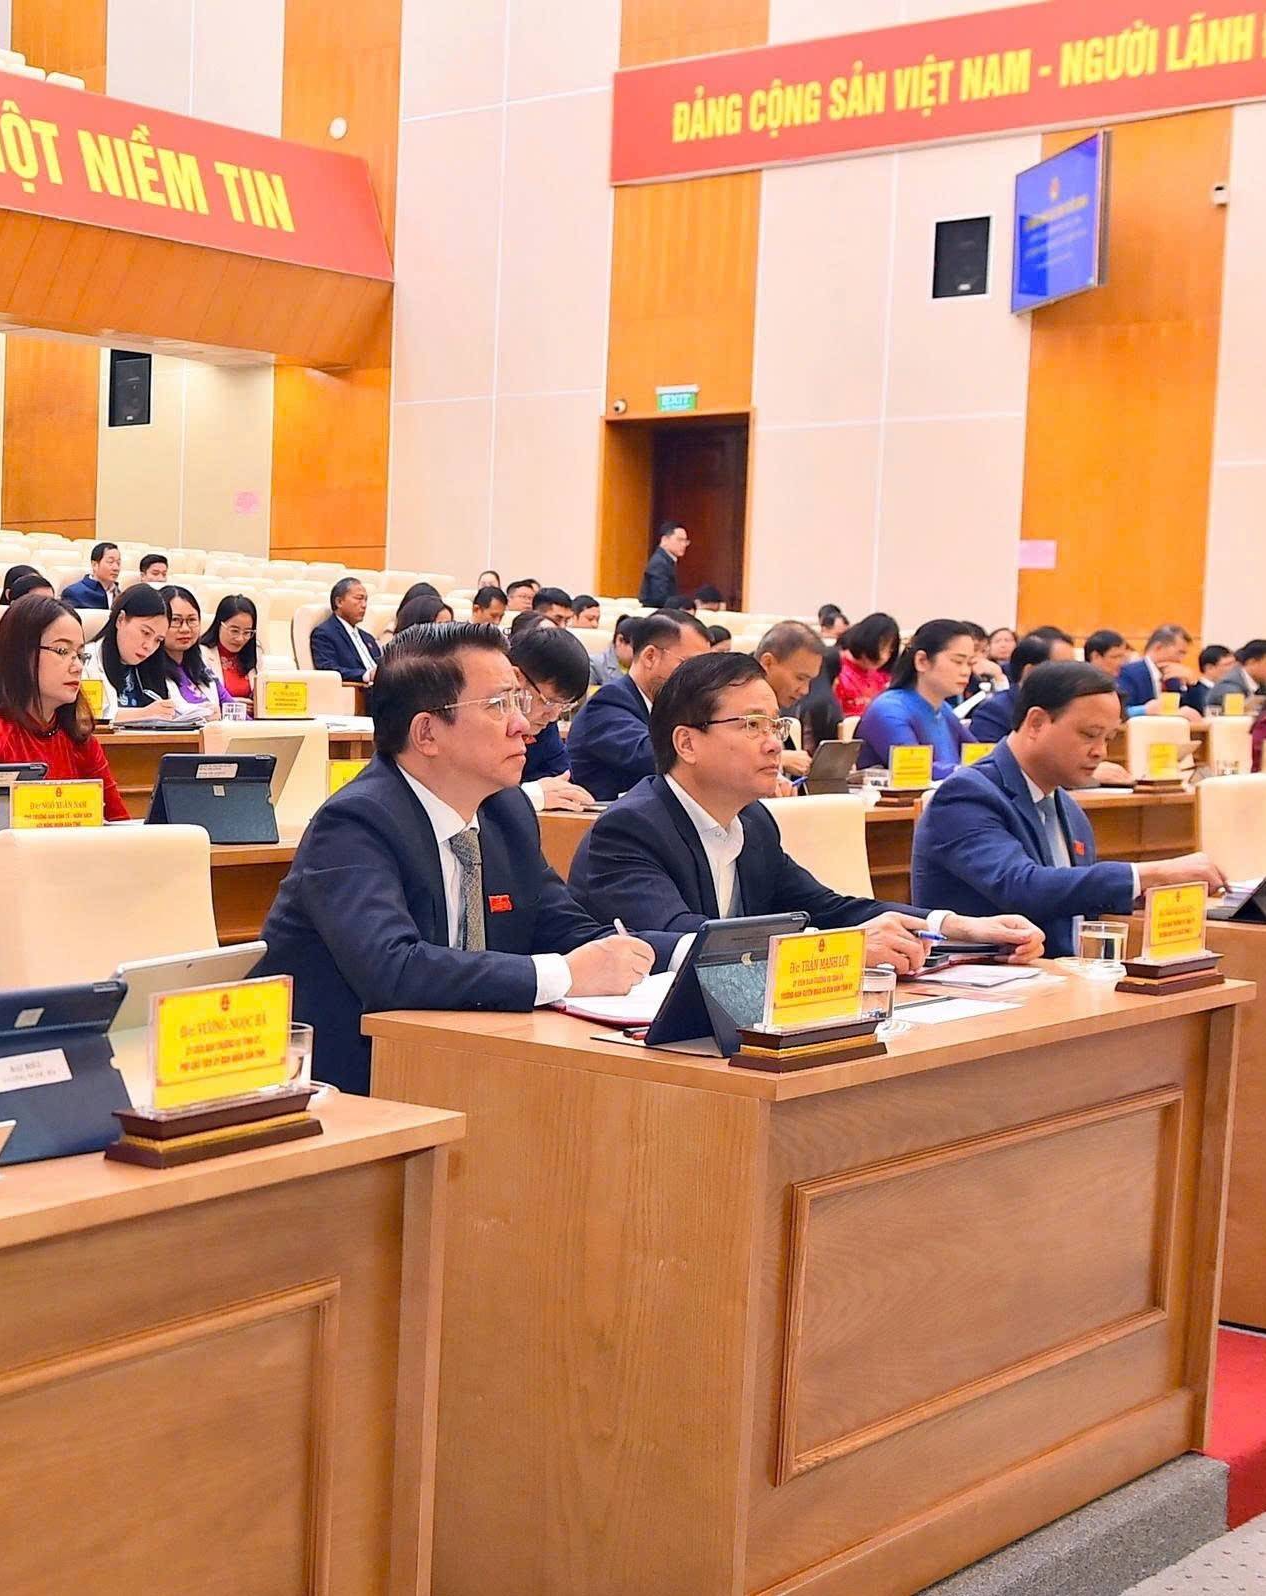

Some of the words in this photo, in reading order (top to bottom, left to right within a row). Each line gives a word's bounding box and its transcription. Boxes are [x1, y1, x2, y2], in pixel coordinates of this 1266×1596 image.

[672, 85, 743, 143] ĐẢNG
[749, 79, 822, 139] CỘNG
[829, 60, 887, 119] SẢN
[894, 55, 954, 116] VIỆT
[960, 49, 1032, 101] NAM
[1060, 19, 1159, 87] NGƯỜI
[1166, 11, 1256, 72] LÃNH
[78, 124, 210, 215] NIỀM
[215, 162, 295, 233] TIN
